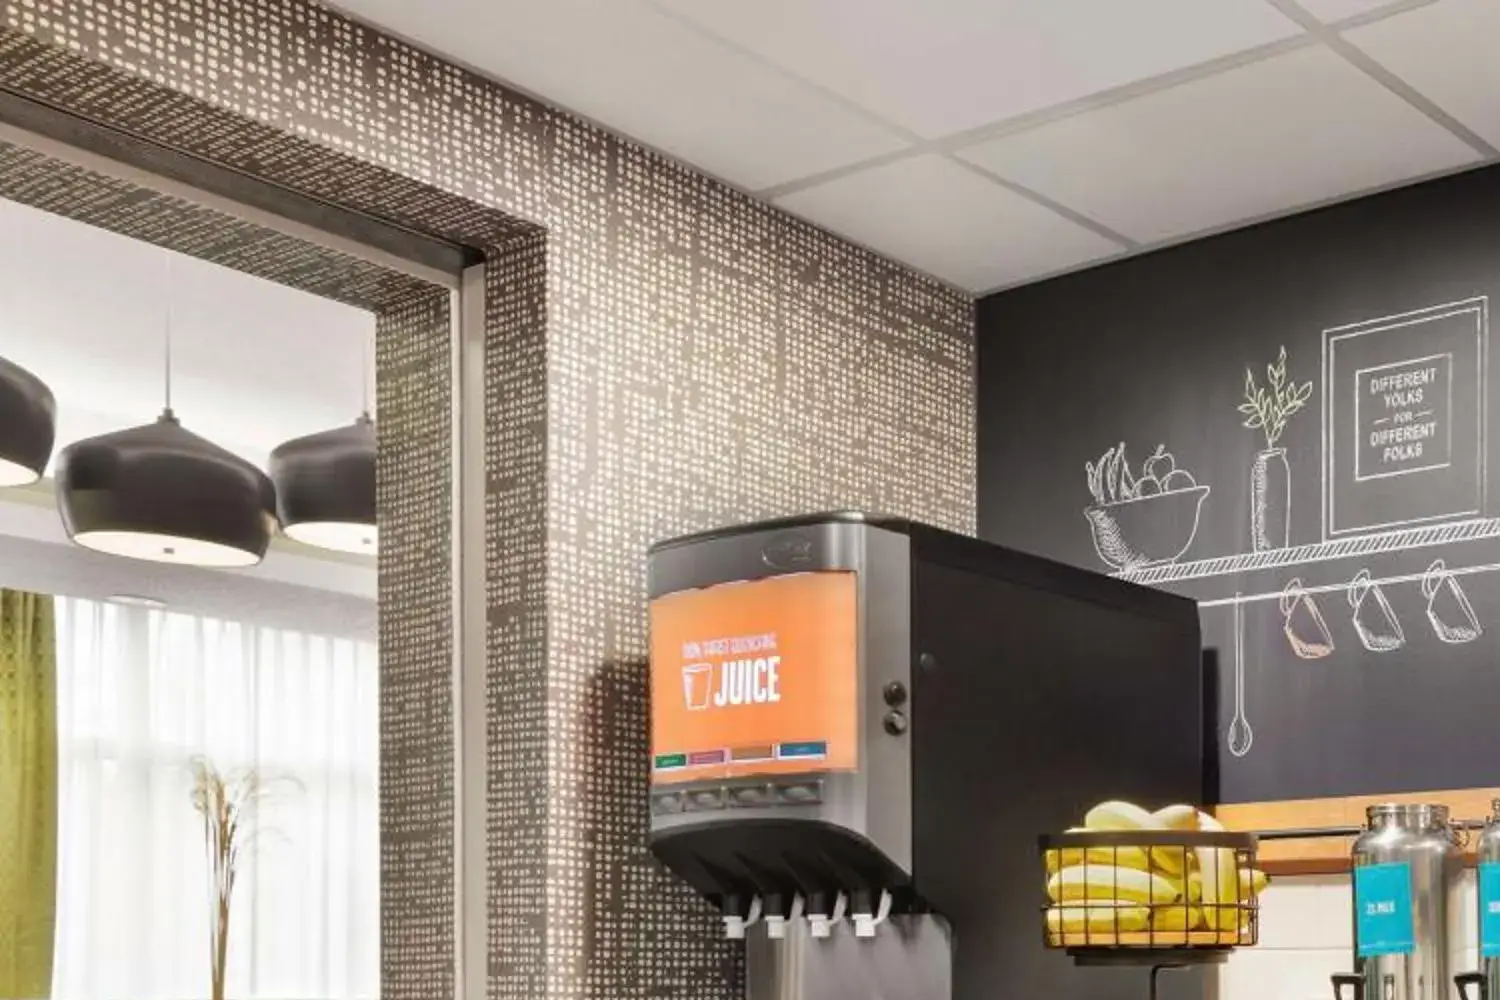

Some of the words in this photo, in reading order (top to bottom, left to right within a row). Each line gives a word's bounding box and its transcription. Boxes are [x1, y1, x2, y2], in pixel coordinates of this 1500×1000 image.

[1369, 367, 1438, 395] DIFFERENT
[1383, 387, 1424, 408] YOLKS
[1369, 421, 1438, 447] DIFFERENT
[1382, 441, 1424, 463] FOLKS
[713, 655, 781, 707] JUICE
